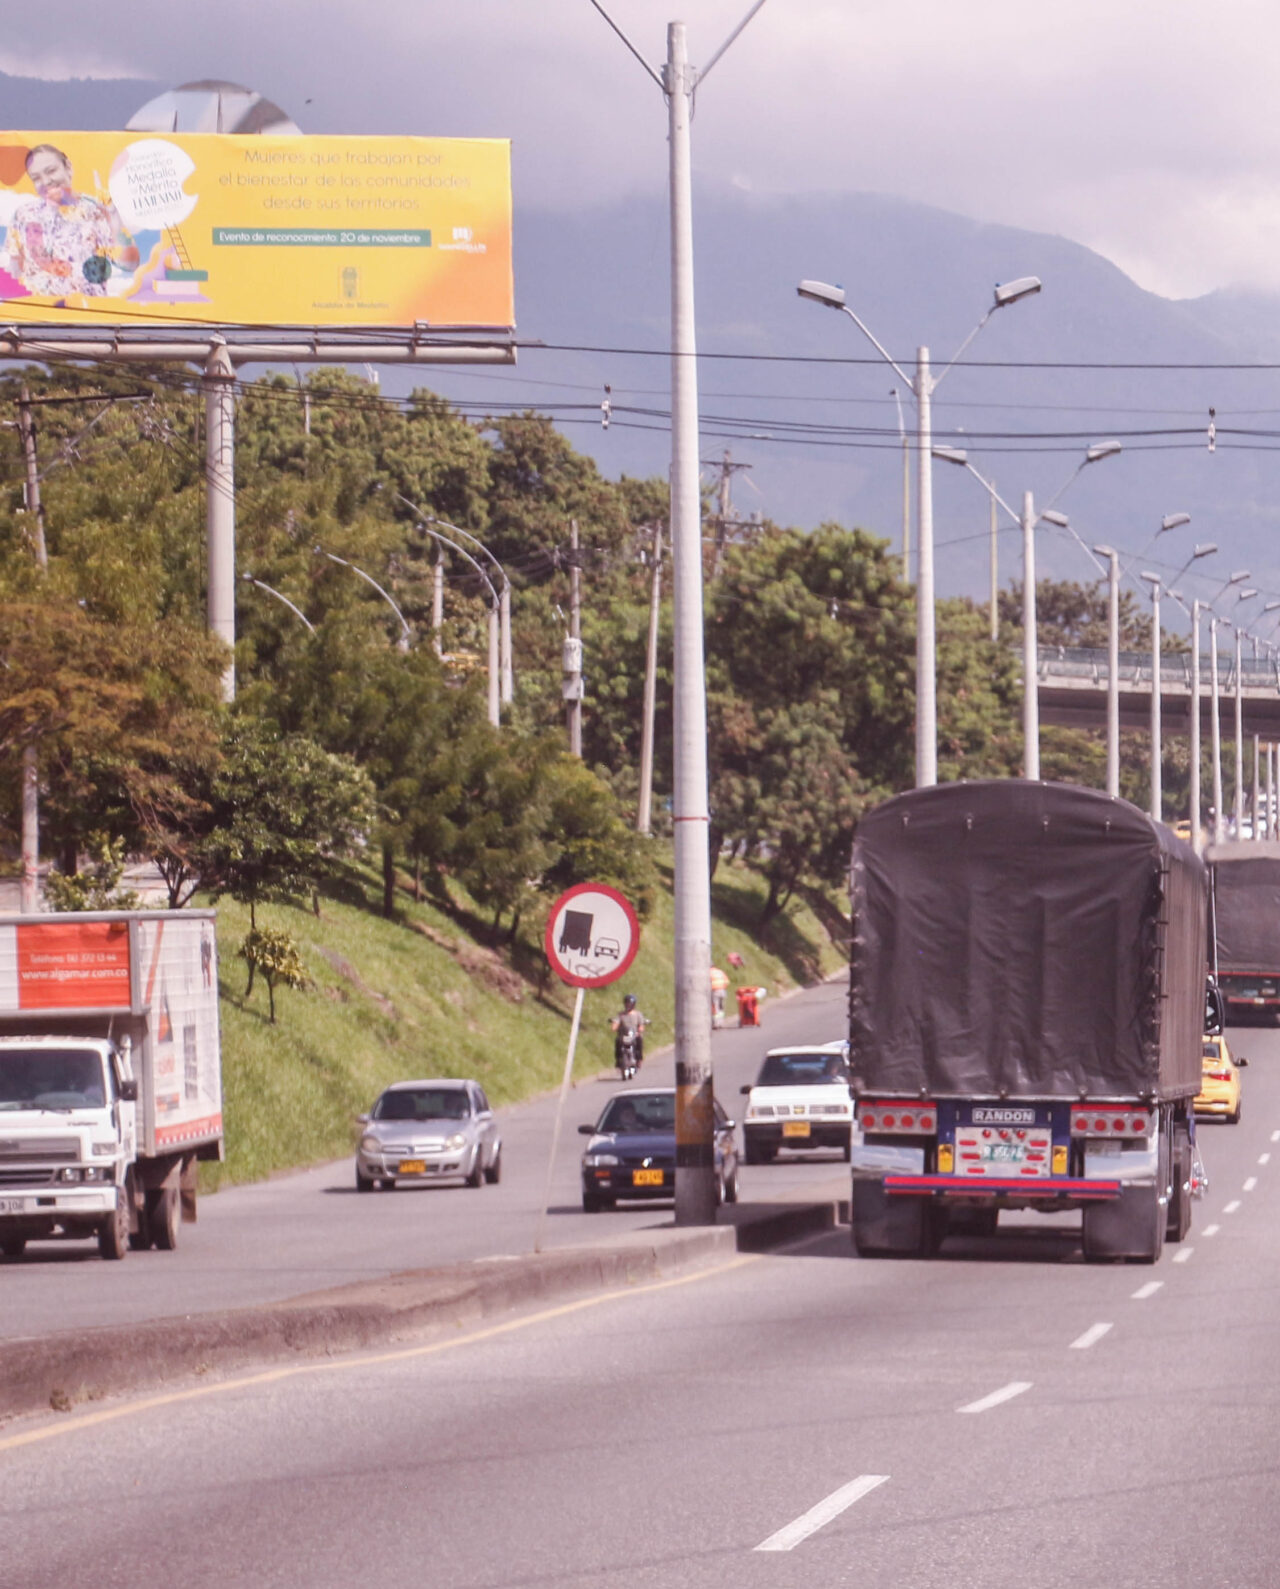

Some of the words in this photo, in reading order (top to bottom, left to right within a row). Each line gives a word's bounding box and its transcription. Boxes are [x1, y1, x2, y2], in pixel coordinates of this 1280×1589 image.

[244, 150, 305, 164] Mujeres
[310, 152, 340, 166] que
[346, 151, 412, 166] trabajan
[416, 154, 441, 166] por
[219, 172, 232, 186] el
[236, 172, 307, 186] bienestar
[315, 173, 336, 187] de
[341, 173, 361, 187] las
[366, 173, 471, 188] comunidades
[263, 194, 312, 209] desde
[316, 198, 341, 209] sus
[346, 196, 420, 210] territorios
[219, 231, 251, 241] Evento
[252, 231, 265, 241] de
[340, 232, 356, 243] 20
[357, 233, 370, 243] de
[371, 232, 421, 243] noviembre
[975, 1110, 1032, 1121] RANDON
